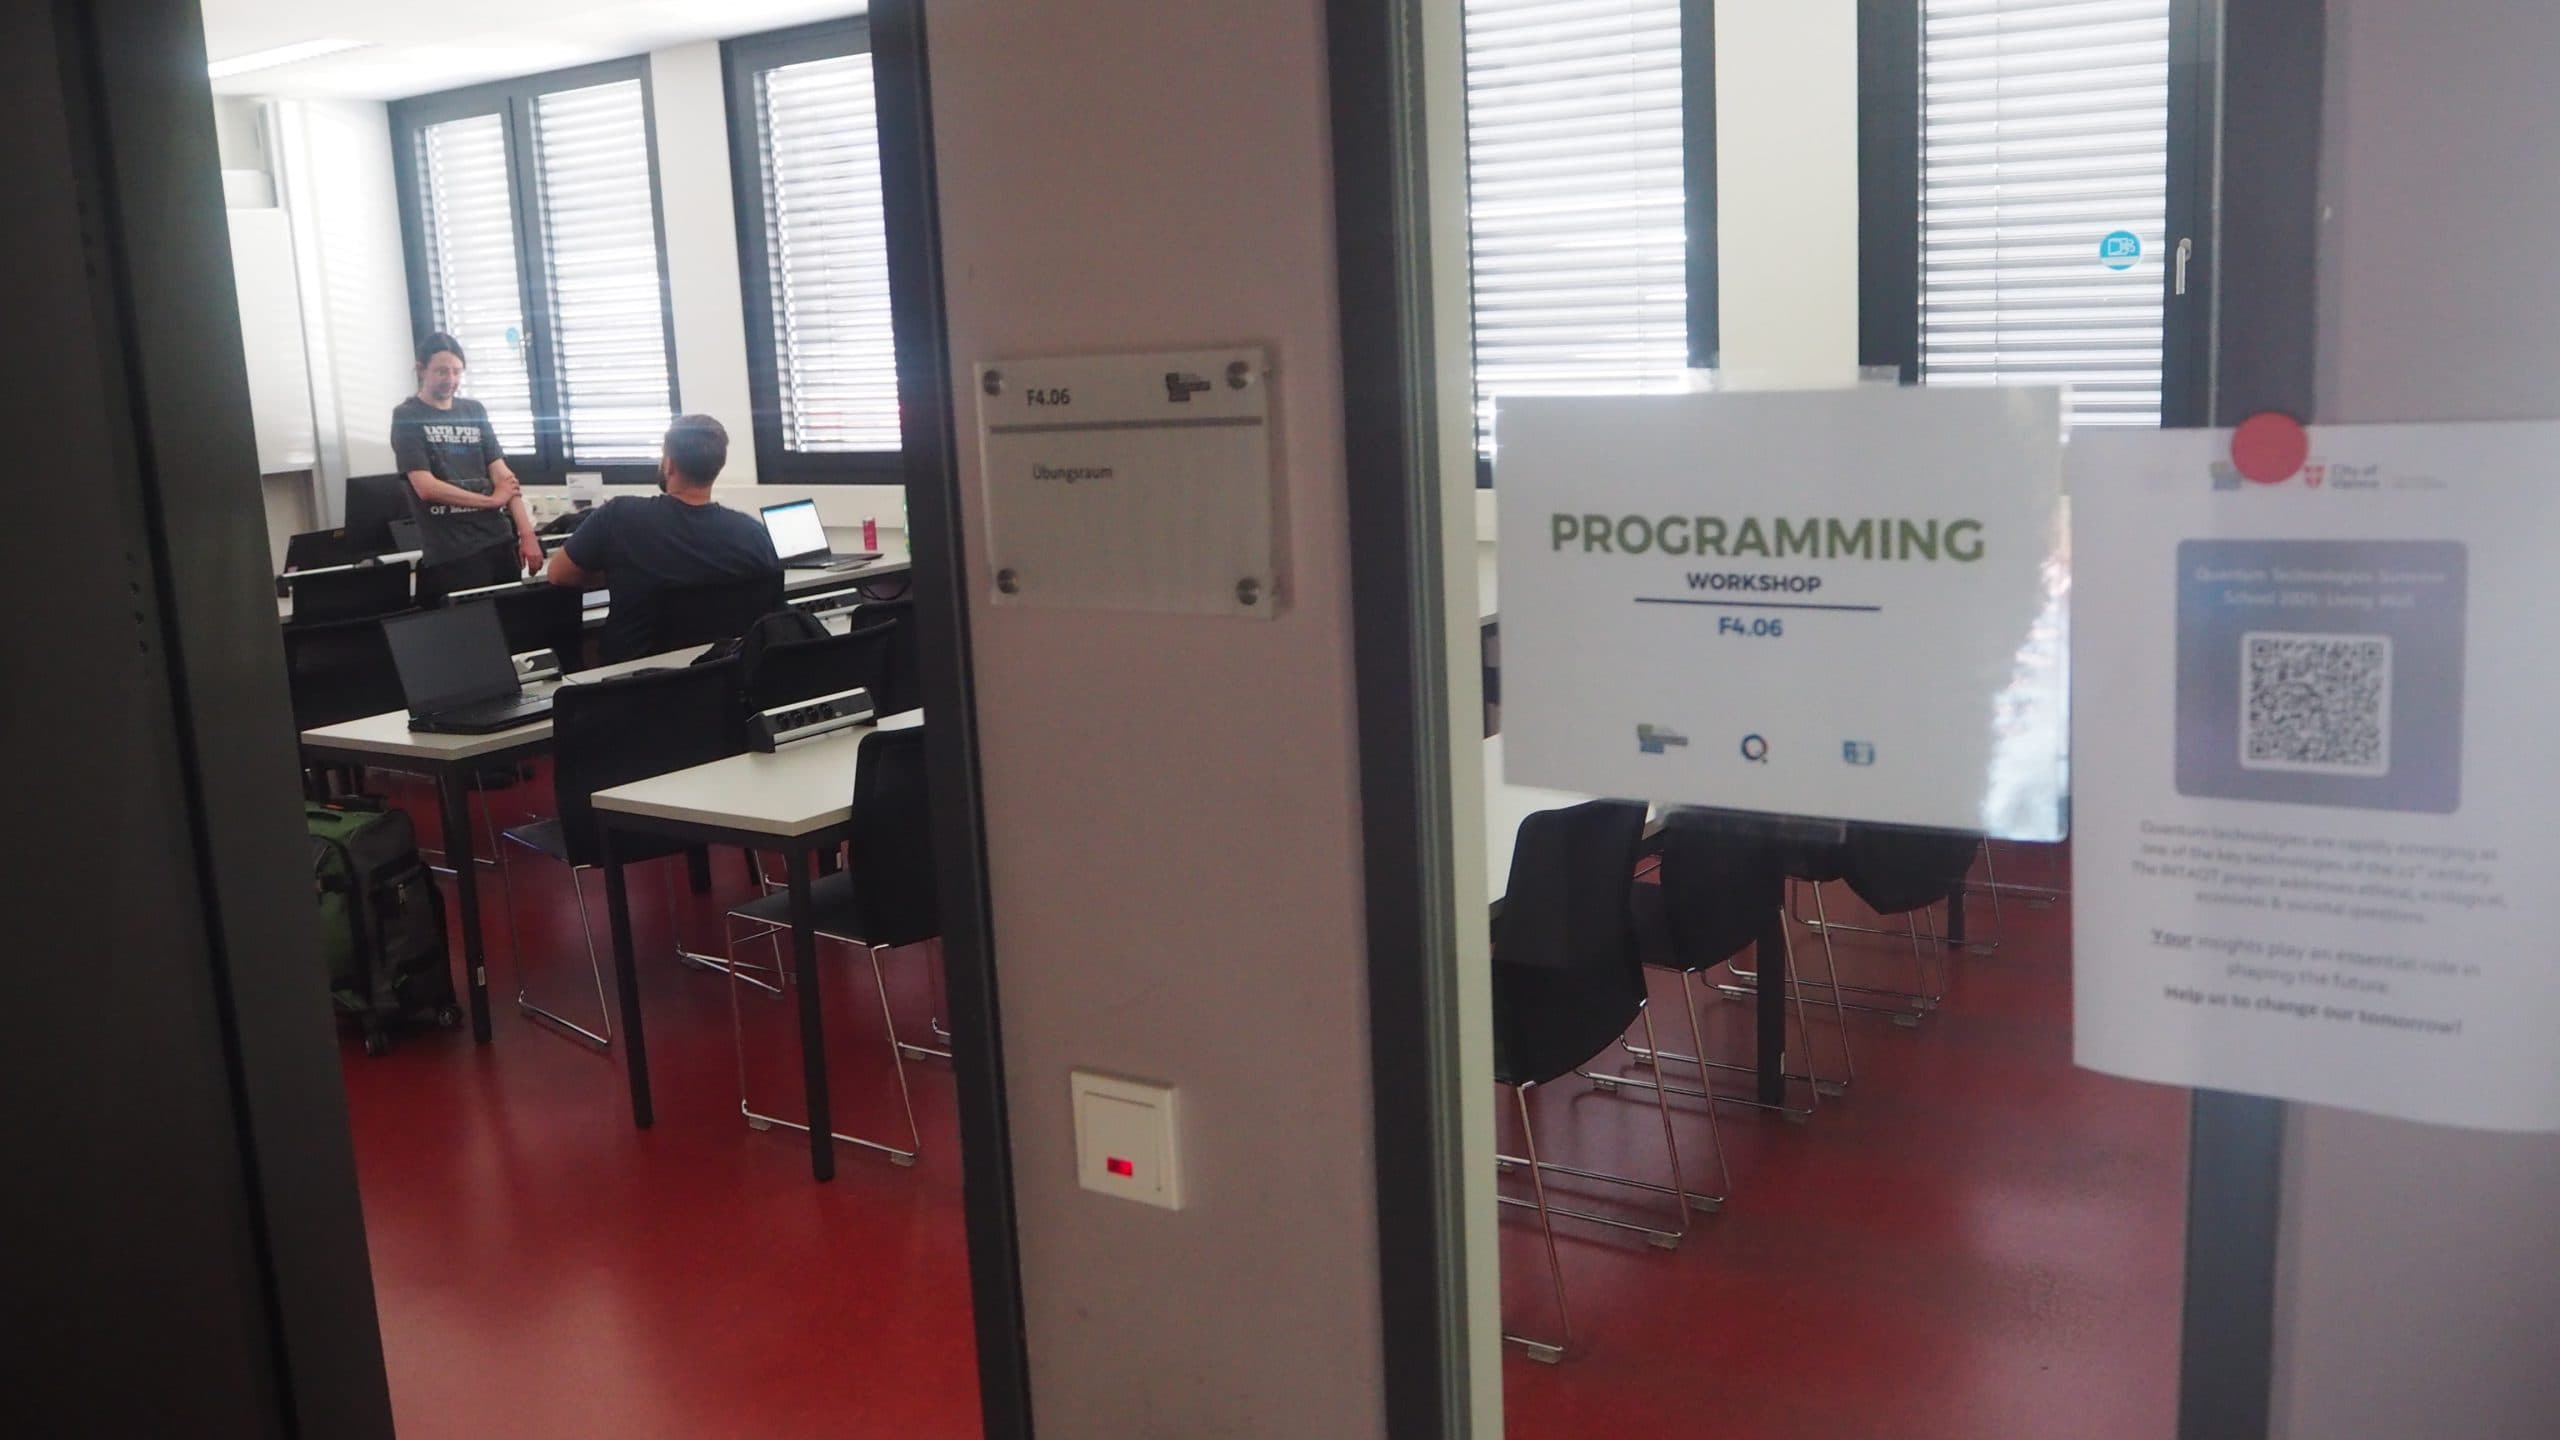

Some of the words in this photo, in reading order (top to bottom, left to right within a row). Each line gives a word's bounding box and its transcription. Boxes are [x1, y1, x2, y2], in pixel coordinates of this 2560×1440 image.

[1027, 387, 1071, 406] F4.06
[1032, 461, 1114, 484] Übungsraum
[1551, 513, 1985, 562] PROGRAMMING
[1687, 572, 1822, 594] WORKSHOP
[1718, 616, 1783, 638] F4.06
[2151, 928, 2193, 949] Your
[2164, 984, 2205, 1005] Help
[2207, 993, 2228, 1007] us
[2231, 993, 2252, 1009] to
[2255, 994, 2319, 1020] change
[2323, 1004, 2353, 1021] our
[2358, 1008, 2463, 1036] tomorrow!
